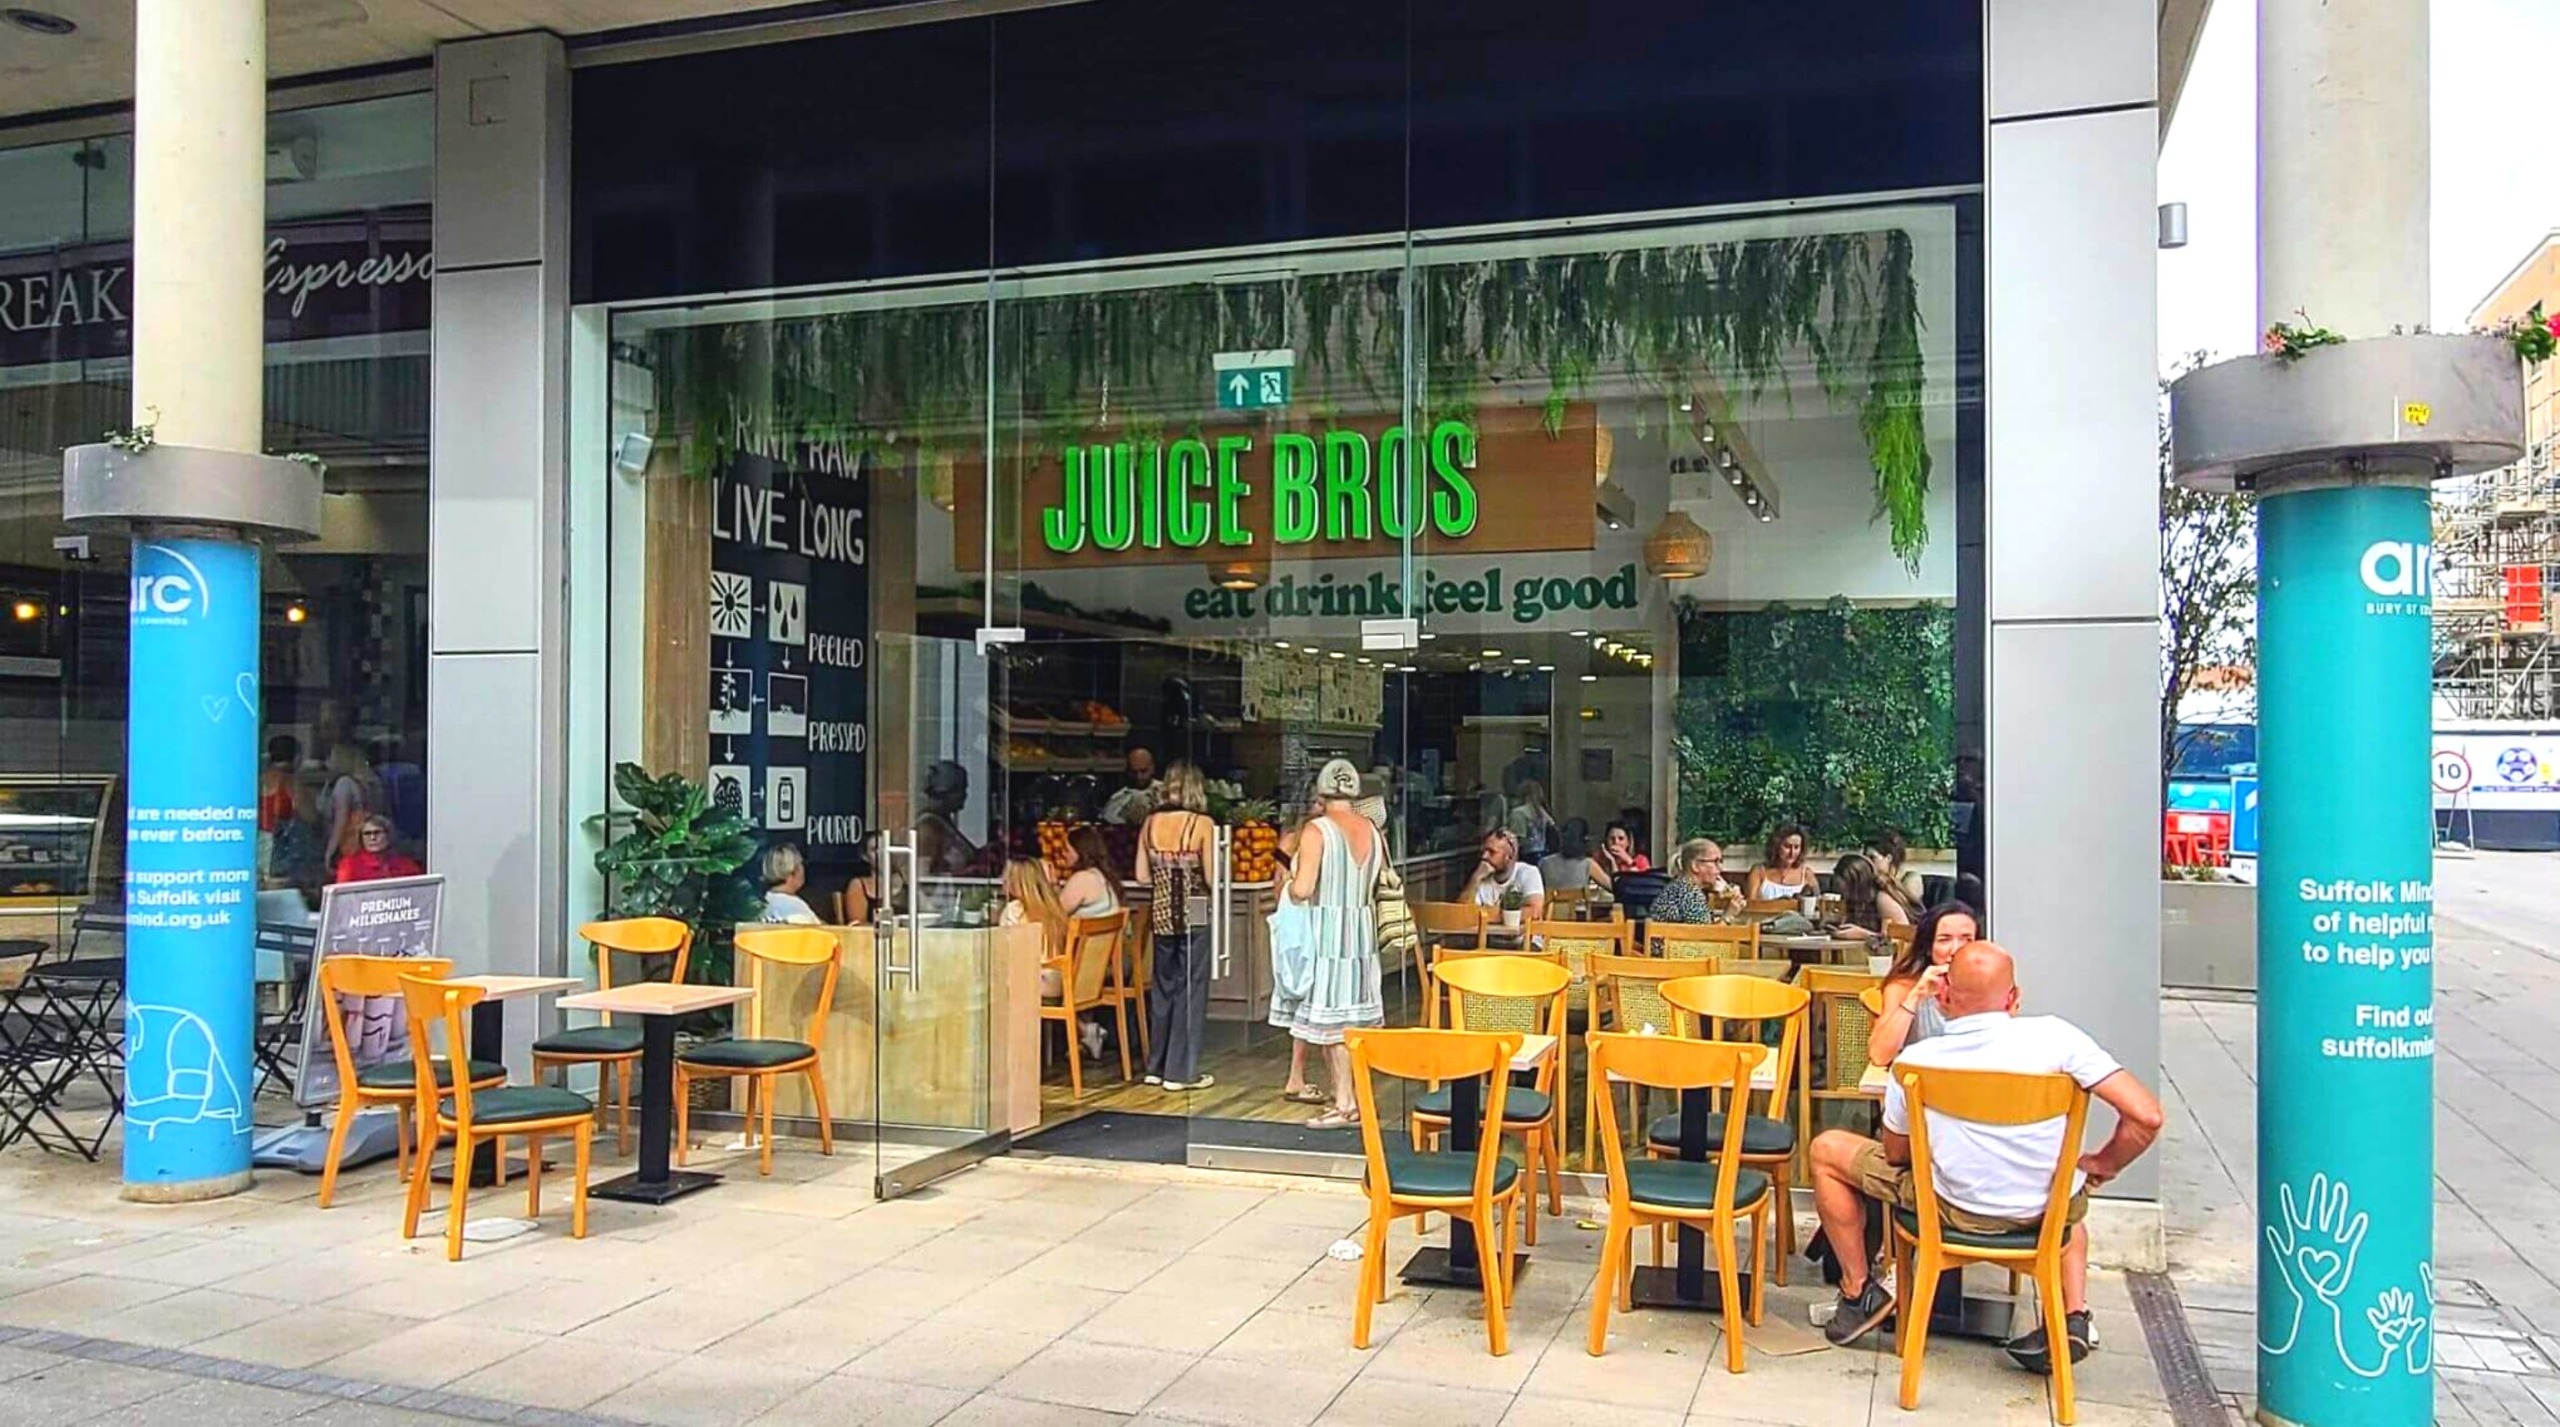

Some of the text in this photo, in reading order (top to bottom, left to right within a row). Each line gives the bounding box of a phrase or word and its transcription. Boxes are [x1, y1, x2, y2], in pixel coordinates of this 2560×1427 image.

[1044, 421, 1478, 552] JUICE BROS
[712, 477, 864, 565] LIVE LONG
[2361, 541, 2431, 596] ar
[130, 575, 192, 613] rc
[1184, 577, 1255, 619] eat
[1265, 572, 1402, 618] drink
[1513, 563, 1638, 623] good
[2366, 602, 2402, 614] BURY
[2438, 763, 2462, 779] 10
[136, 808, 160, 820] are
[164, 805, 234, 821] needed
[140, 829, 177, 842] ever
[182, 827, 245, 842] before.
[136, 870, 205, 888] support
[209, 870, 250, 883] more
[137, 889, 200, 906] Suffolk
[204, 888, 242, 904] visit
[2299, 879, 2395, 903] Suffolk
[361, 896, 412, 914] PREMIUM
[349, 908, 420, 929] MILKSHAKES
[2313, 911, 2342, 932] of
[2349, 911, 2425, 939] helpful
[2303, 941, 2330, 962] to
[2337, 942, 2395, 971] help
[2356, 1004, 2410, 1027] Find
